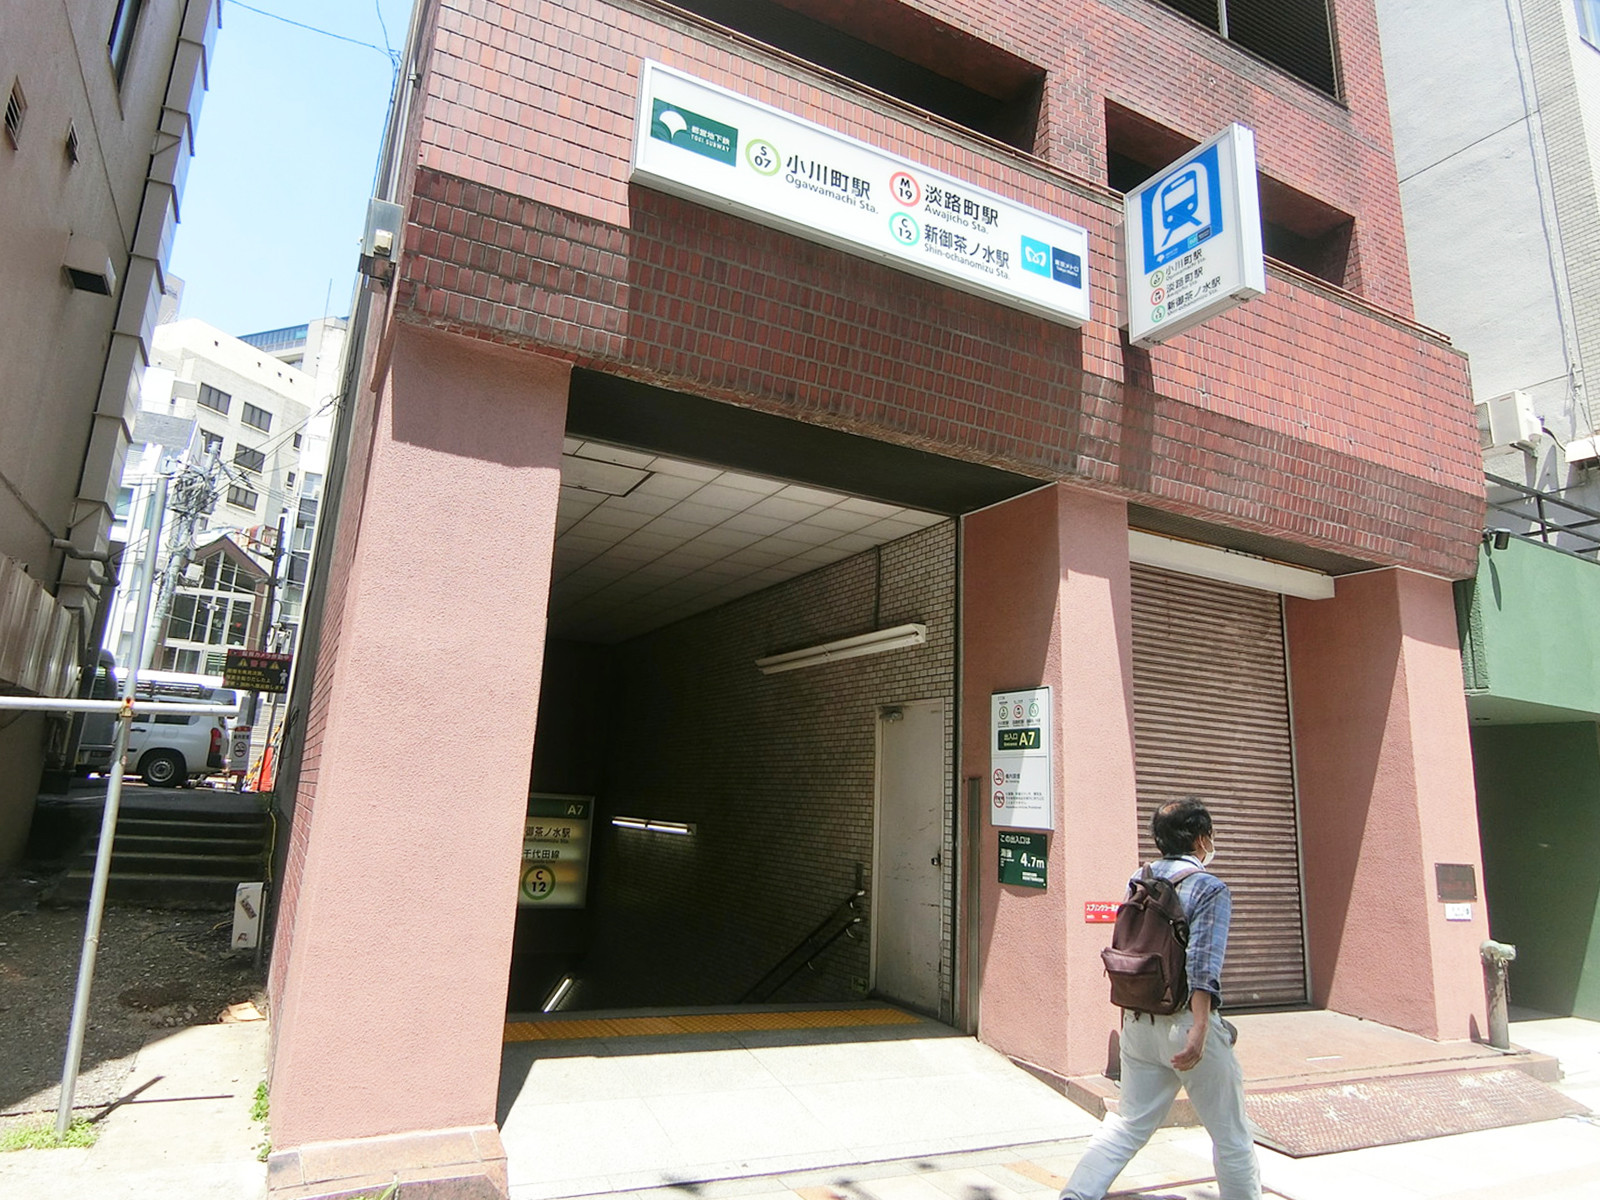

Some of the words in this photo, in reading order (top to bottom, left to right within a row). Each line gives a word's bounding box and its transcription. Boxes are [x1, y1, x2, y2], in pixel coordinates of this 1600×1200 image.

[691, 133, 704, 143] TOEI
[705, 138, 730, 153] SUBWAY
[760, 145, 768, 156] S
[754, 155, 772, 168] 07
[786, 154, 871, 201] 小川町駅
[900, 177, 911, 189] M
[785, 173, 857, 206] Ogawamachi
[859, 199, 879, 214] Sta.
[899, 187, 913, 200] 19
[925, 184, 998, 227] 淡路町駅
[901, 218, 908, 229] C
[924, 204, 969, 227] Awajicho
[971, 221, 989, 235] Sta.
[899, 227, 912, 241] 12
[924, 224, 1009, 270] 新御茶ノ水駅
[924, 243, 994, 275] Shin-ochanomizu
[996, 267, 1011, 281] Sta.
[1166, 248, 1203, 276] 小川町駅
[1167, 266, 1203, 293] 淡路町駅
[1167, 276, 1221, 310] 新御茶ノ水駅
[1003, 733, 1018, 741] 出入口
[1019, 731, 1036, 747] A7
[567, 804, 584, 815] A7
[1000, 834, 1031, 845] この出入口は
[524, 849, 560, 859] 千代田線
[1020, 852, 1045, 869] 4.7m
[536, 870, 543, 881] C
[532, 881, 547, 893] 12
